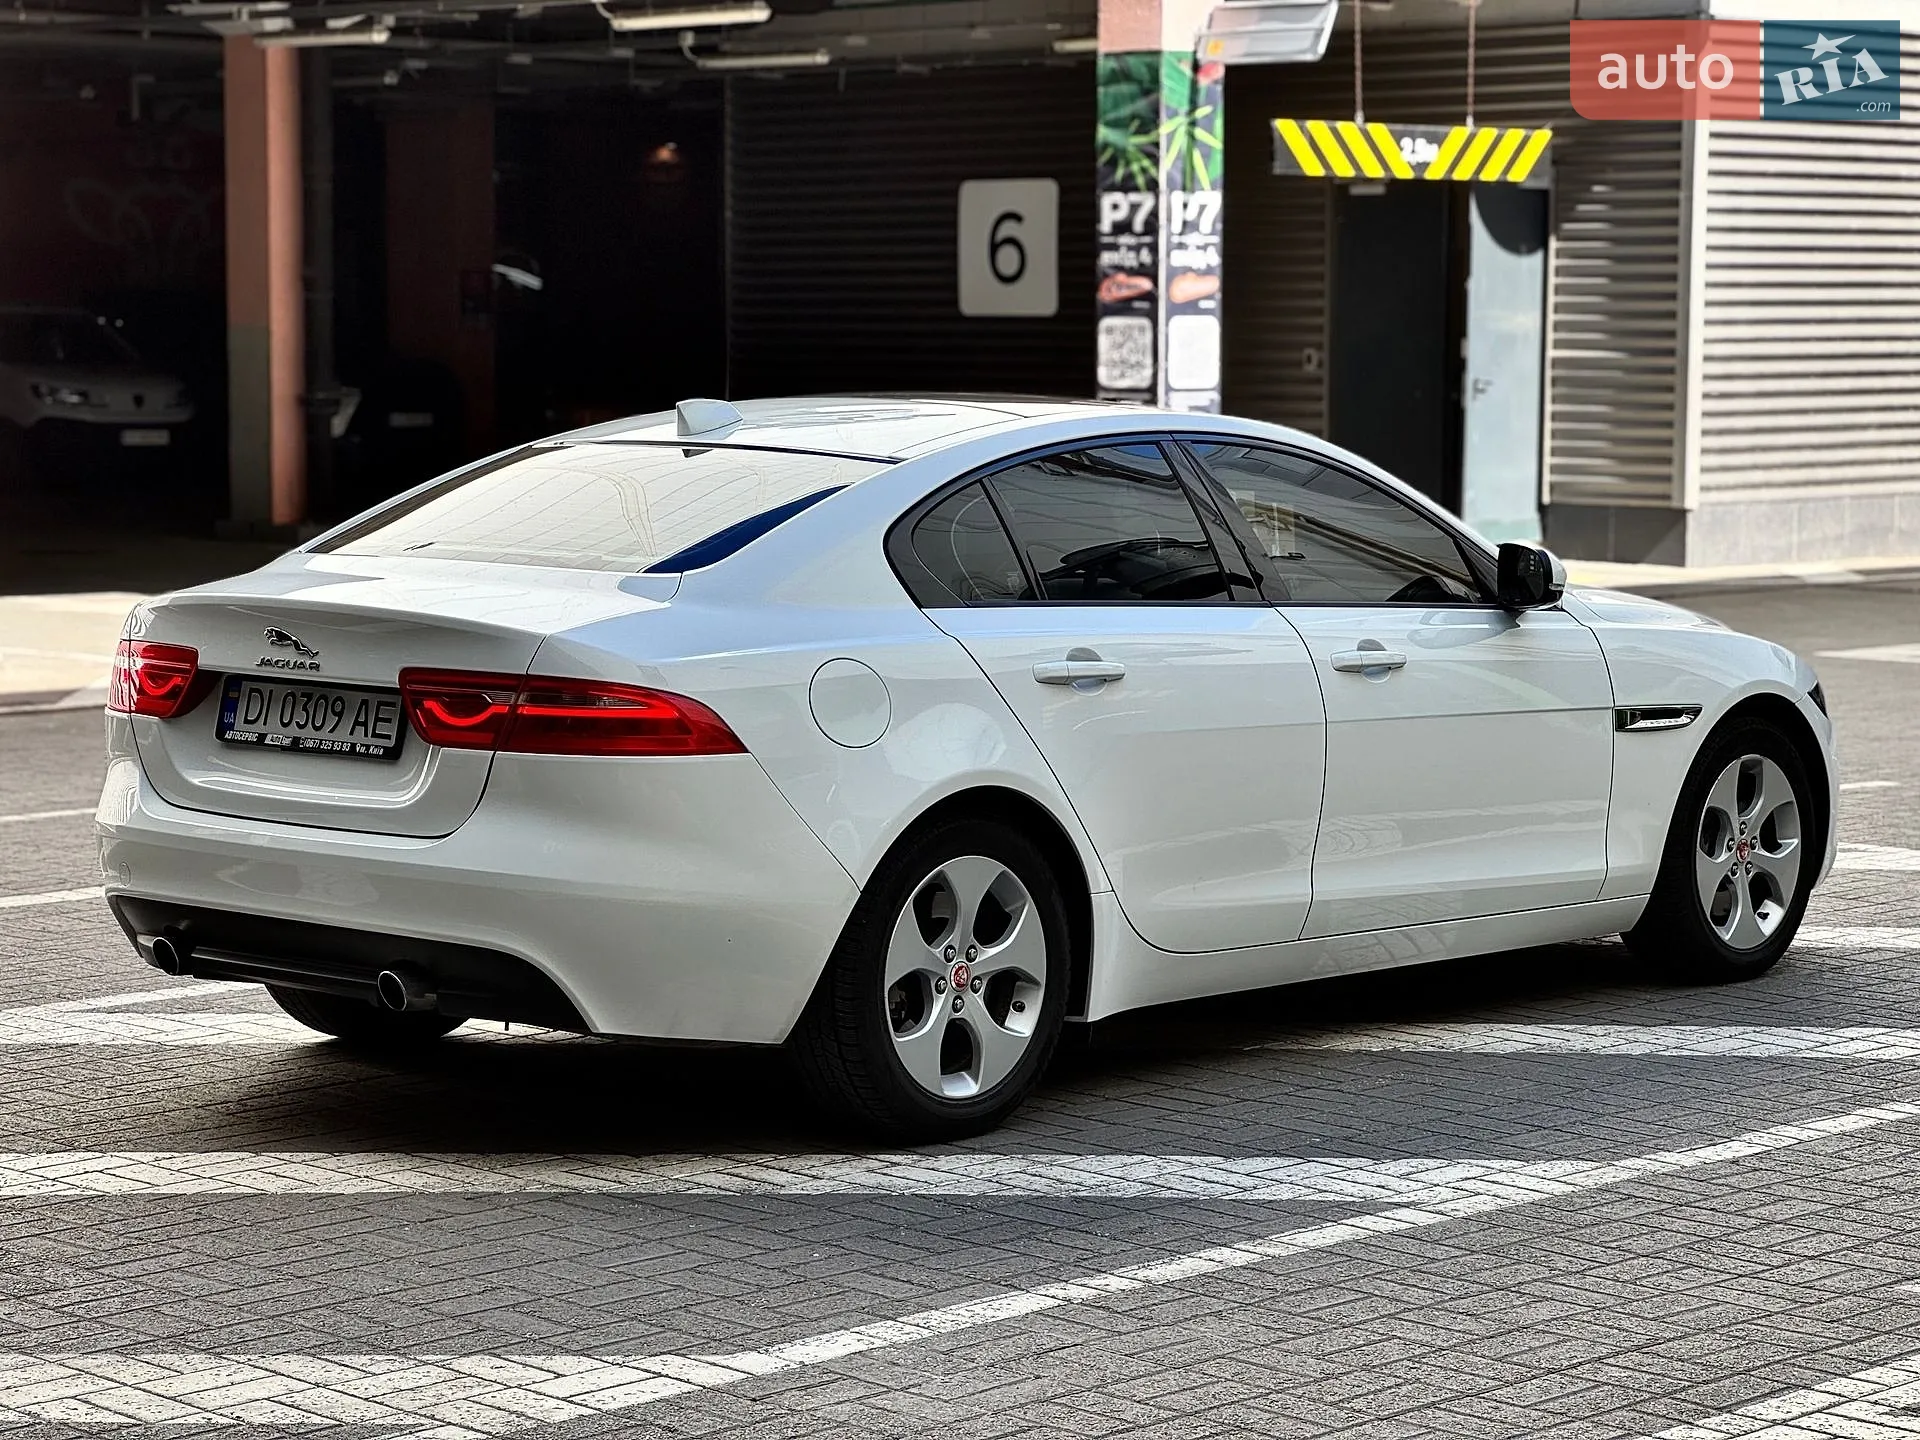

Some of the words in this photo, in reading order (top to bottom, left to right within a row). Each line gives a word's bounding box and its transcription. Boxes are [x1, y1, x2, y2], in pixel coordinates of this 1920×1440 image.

[1100, 191, 1156, 234] P7
[989, 212, 1026, 284] 6
[255, 656, 321, 671] JAGUAR
[224, 712, 235, 723] UA
[243, 687, 273, 726] DI
[279, 690, 345, 733] 0309
[349, 698, 397, 740] AE
[224, 730, 258, 742] АВТОСЕРВІС
[320, 740, 334, 750] 325
[333, 741, 342, 751] 93
[342, 742, 351, 752] 93
[369, 745, 384, 755] Київ
